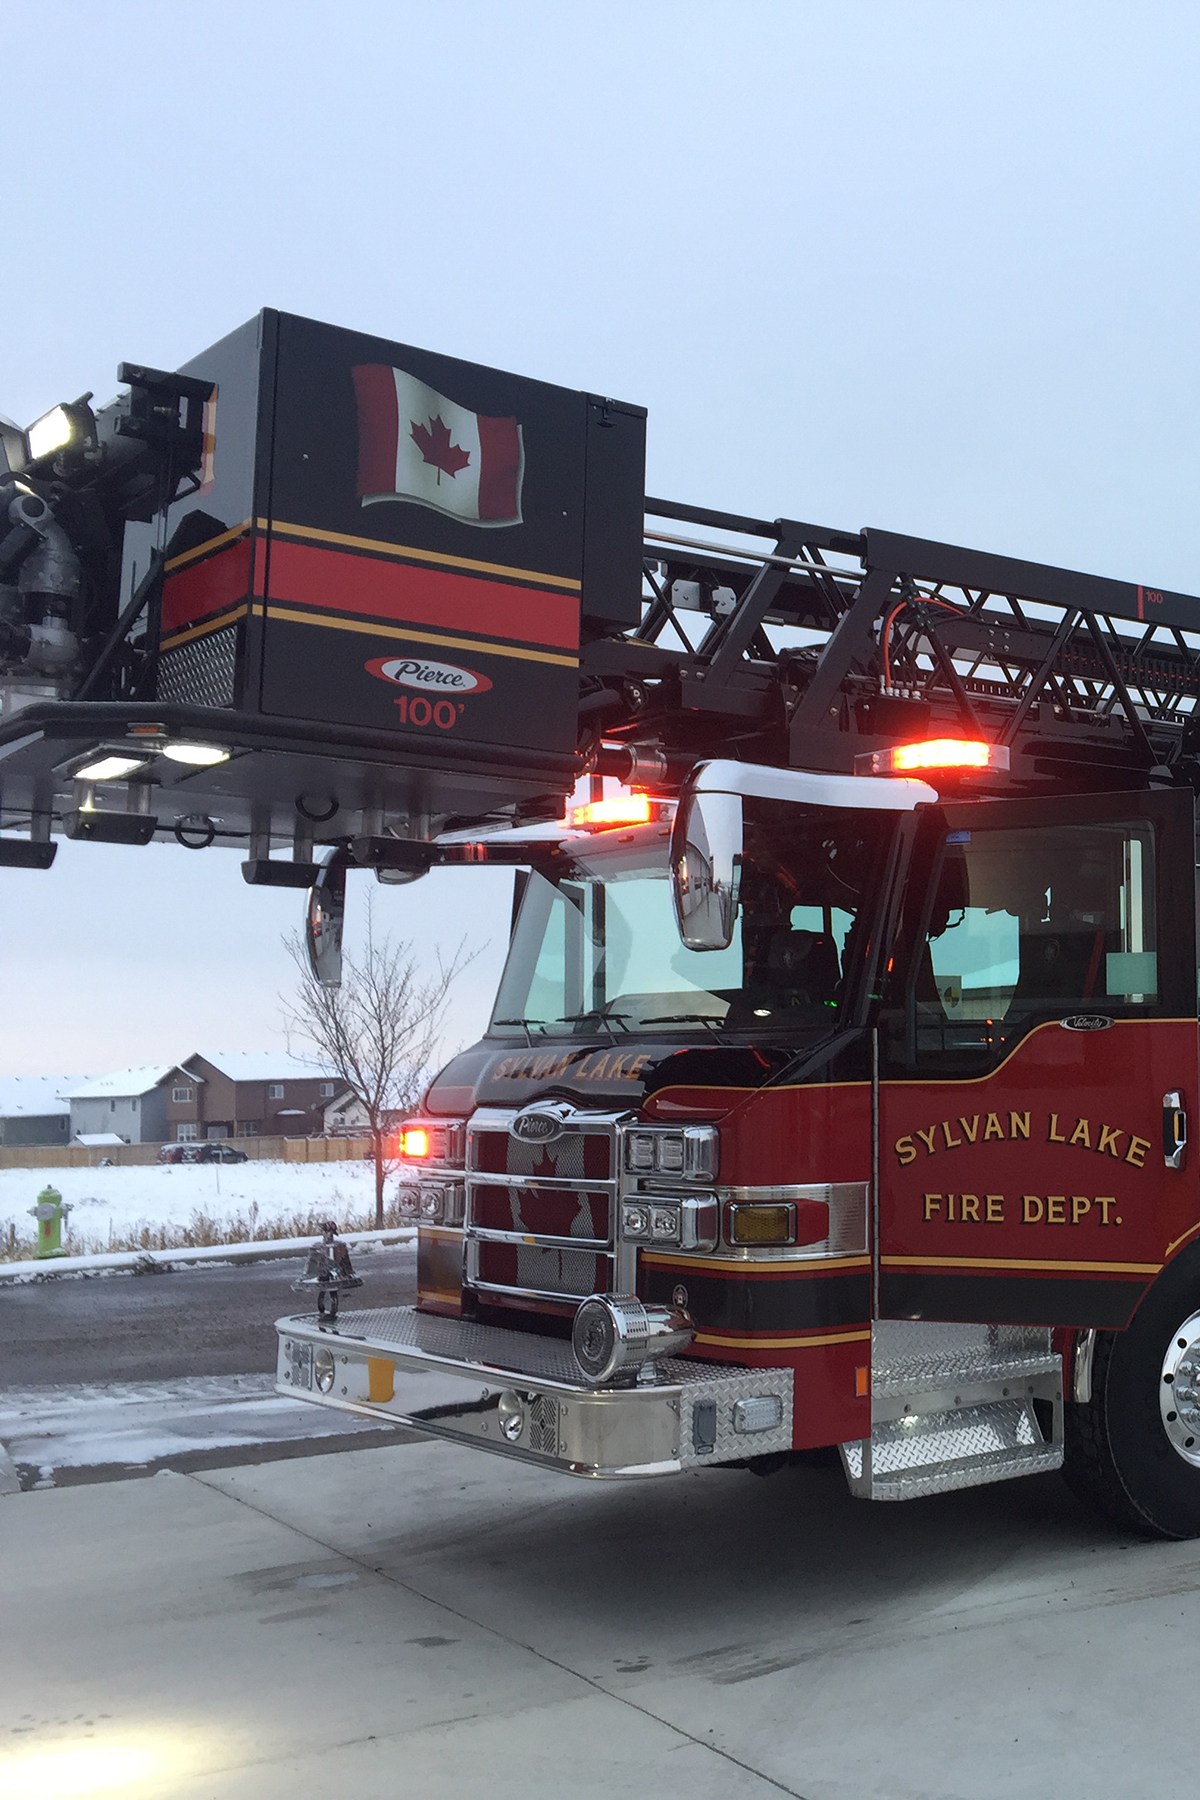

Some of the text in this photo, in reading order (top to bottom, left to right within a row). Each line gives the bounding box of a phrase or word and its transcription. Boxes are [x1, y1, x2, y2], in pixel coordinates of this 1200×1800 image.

[1146, 590, 1164, 605] 100
[394, 660, 463, 687] Pierce
[574, 1053, 651, 1081] LAKE
[895, 1111, 1152, 1168] SYLVAN LAKE
[924, 1193, 1123, 1225] FIRE DEPT.
